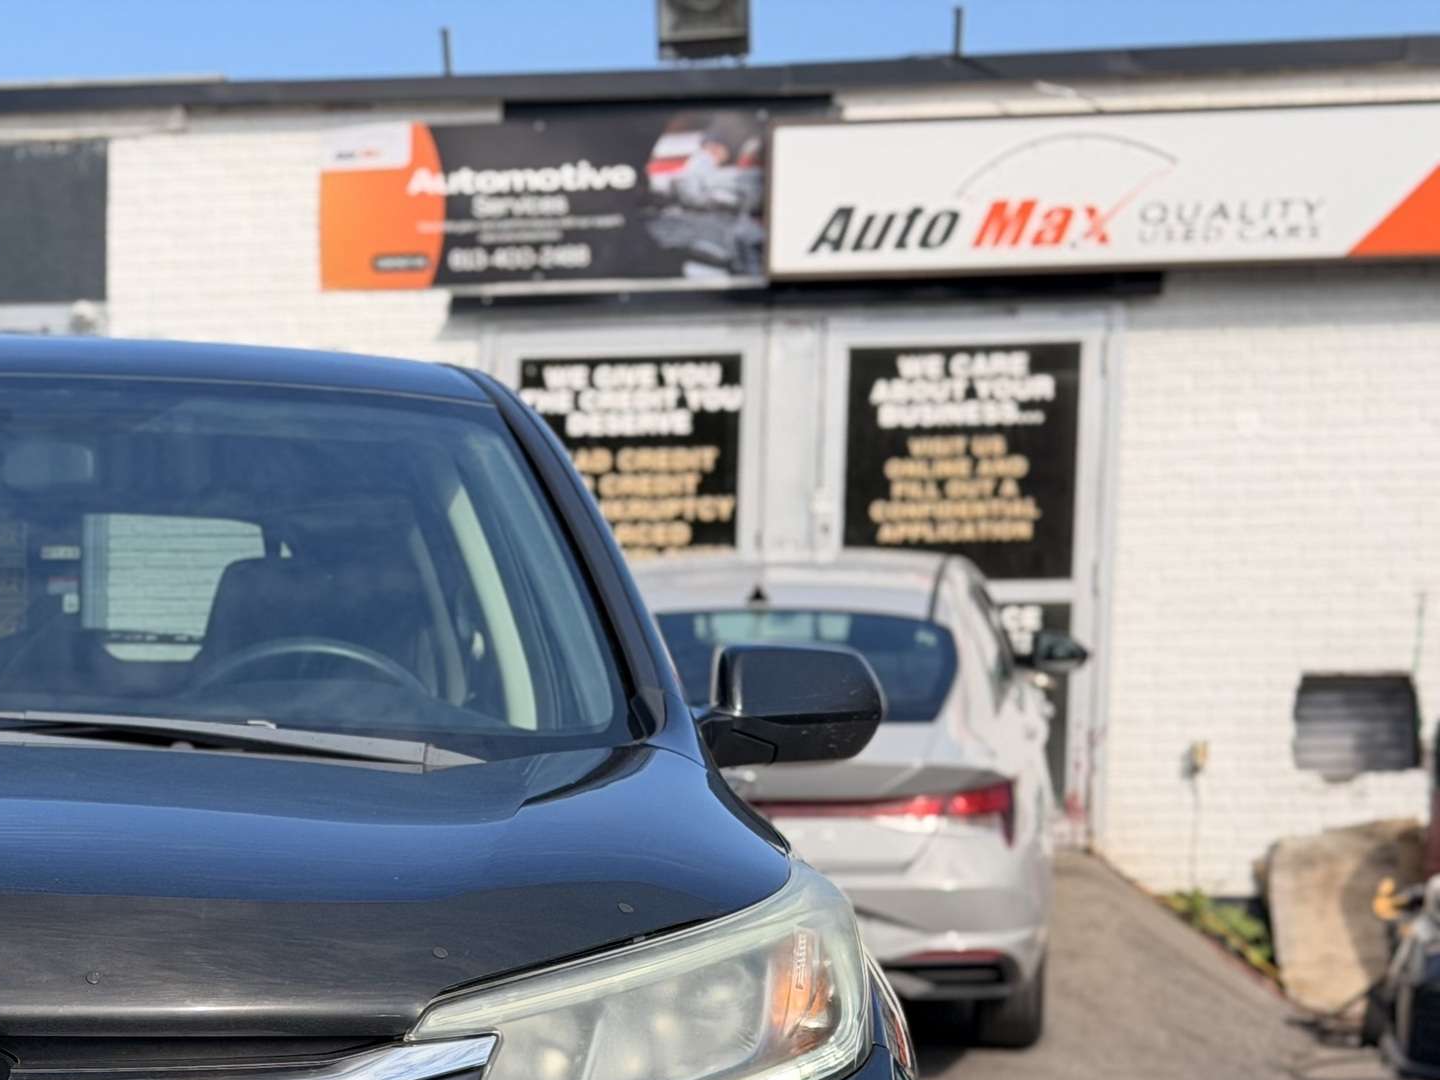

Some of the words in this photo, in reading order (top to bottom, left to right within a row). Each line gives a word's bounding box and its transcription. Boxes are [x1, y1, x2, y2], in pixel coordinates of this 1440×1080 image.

[407, 160, 635, 196] Automotive
[1139, 197, 1326, 226] QUALITY
[808, 205, 961, 253] Auto
[972, 199, 1112, 248] Max
[542, 364, 590, 389] WE
[592, 363, 659, 389] GIVE
[661, 362, 722, 388] YOU
[896, 353, 946, 379] WE
[949, 351, 1030, 378] CARE
[869, 376, 970, 405] ABOUT
[973, 373, 1056, 402] YOUR
[571, 447, 613, 473] AD
[976, 454, 1030, 479] AND
[998, 476, 1020, 499] A
